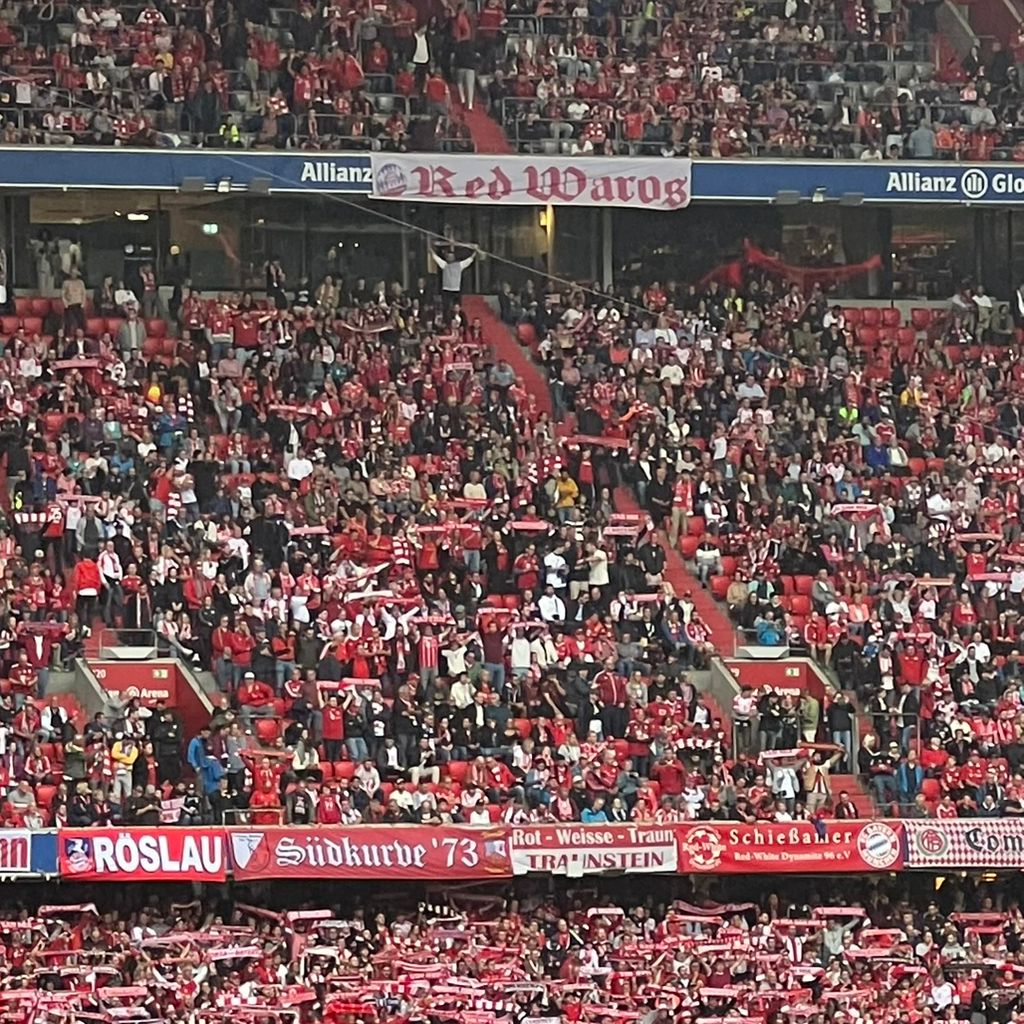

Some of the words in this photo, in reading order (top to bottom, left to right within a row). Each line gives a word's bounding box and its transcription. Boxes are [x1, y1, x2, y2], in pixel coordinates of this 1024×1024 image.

[301, 161, 372, 183] Allianz
[410, 165, 513, 200] Red
[886, 172, 957, 193] Allianz
[512, 829, 542, 845] Rot
[556, 829, 614, 844] Weisse
[92, 832, 222, 873] RÖSLAU
[276, 836, 426, 867] Südkurve
[431, 837, 479, 867] '73
